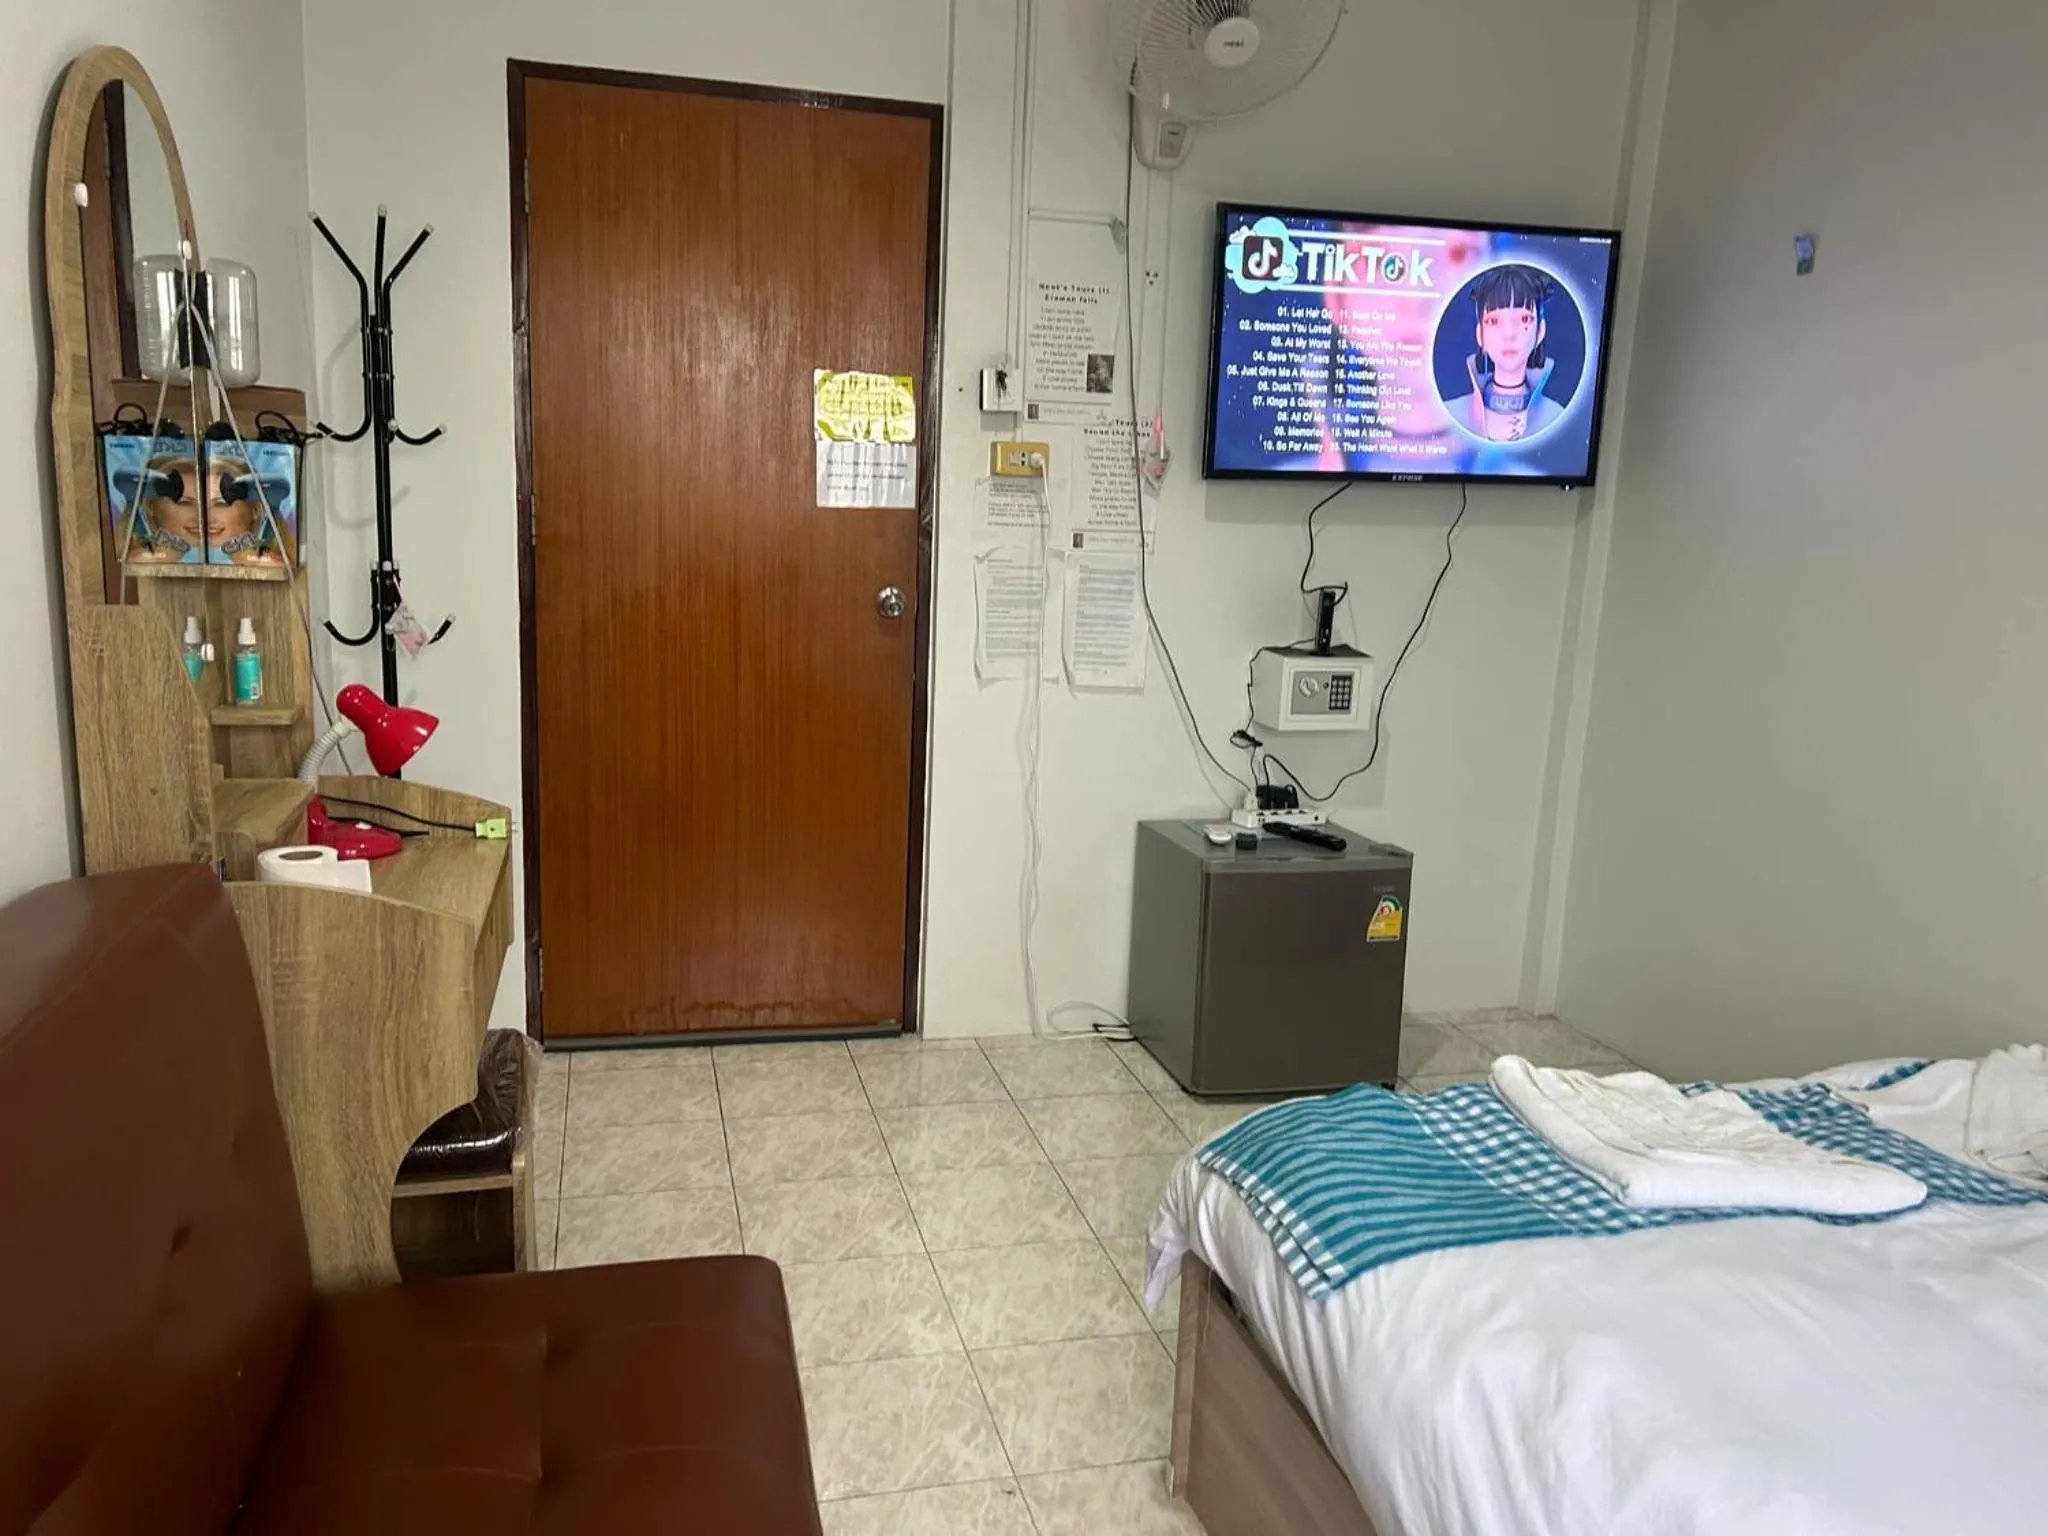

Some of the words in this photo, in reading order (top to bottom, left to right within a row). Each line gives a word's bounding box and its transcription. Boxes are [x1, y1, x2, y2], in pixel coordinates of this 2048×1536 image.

[1301, 242, 1434, 287] TikTok
[1253, 320, 1290, 332] Someone
[1291, 321, 1307, 333] You
[1308, 322, 1333, 334] Loved
[1295, 337, 1307, 350] My
[1308, 338, 1331, 349] Worst
[1240, 365, 1258, 377] Just
[1258, 365, 1277, 377] Give
[1291, 367, 1299, 378] A
